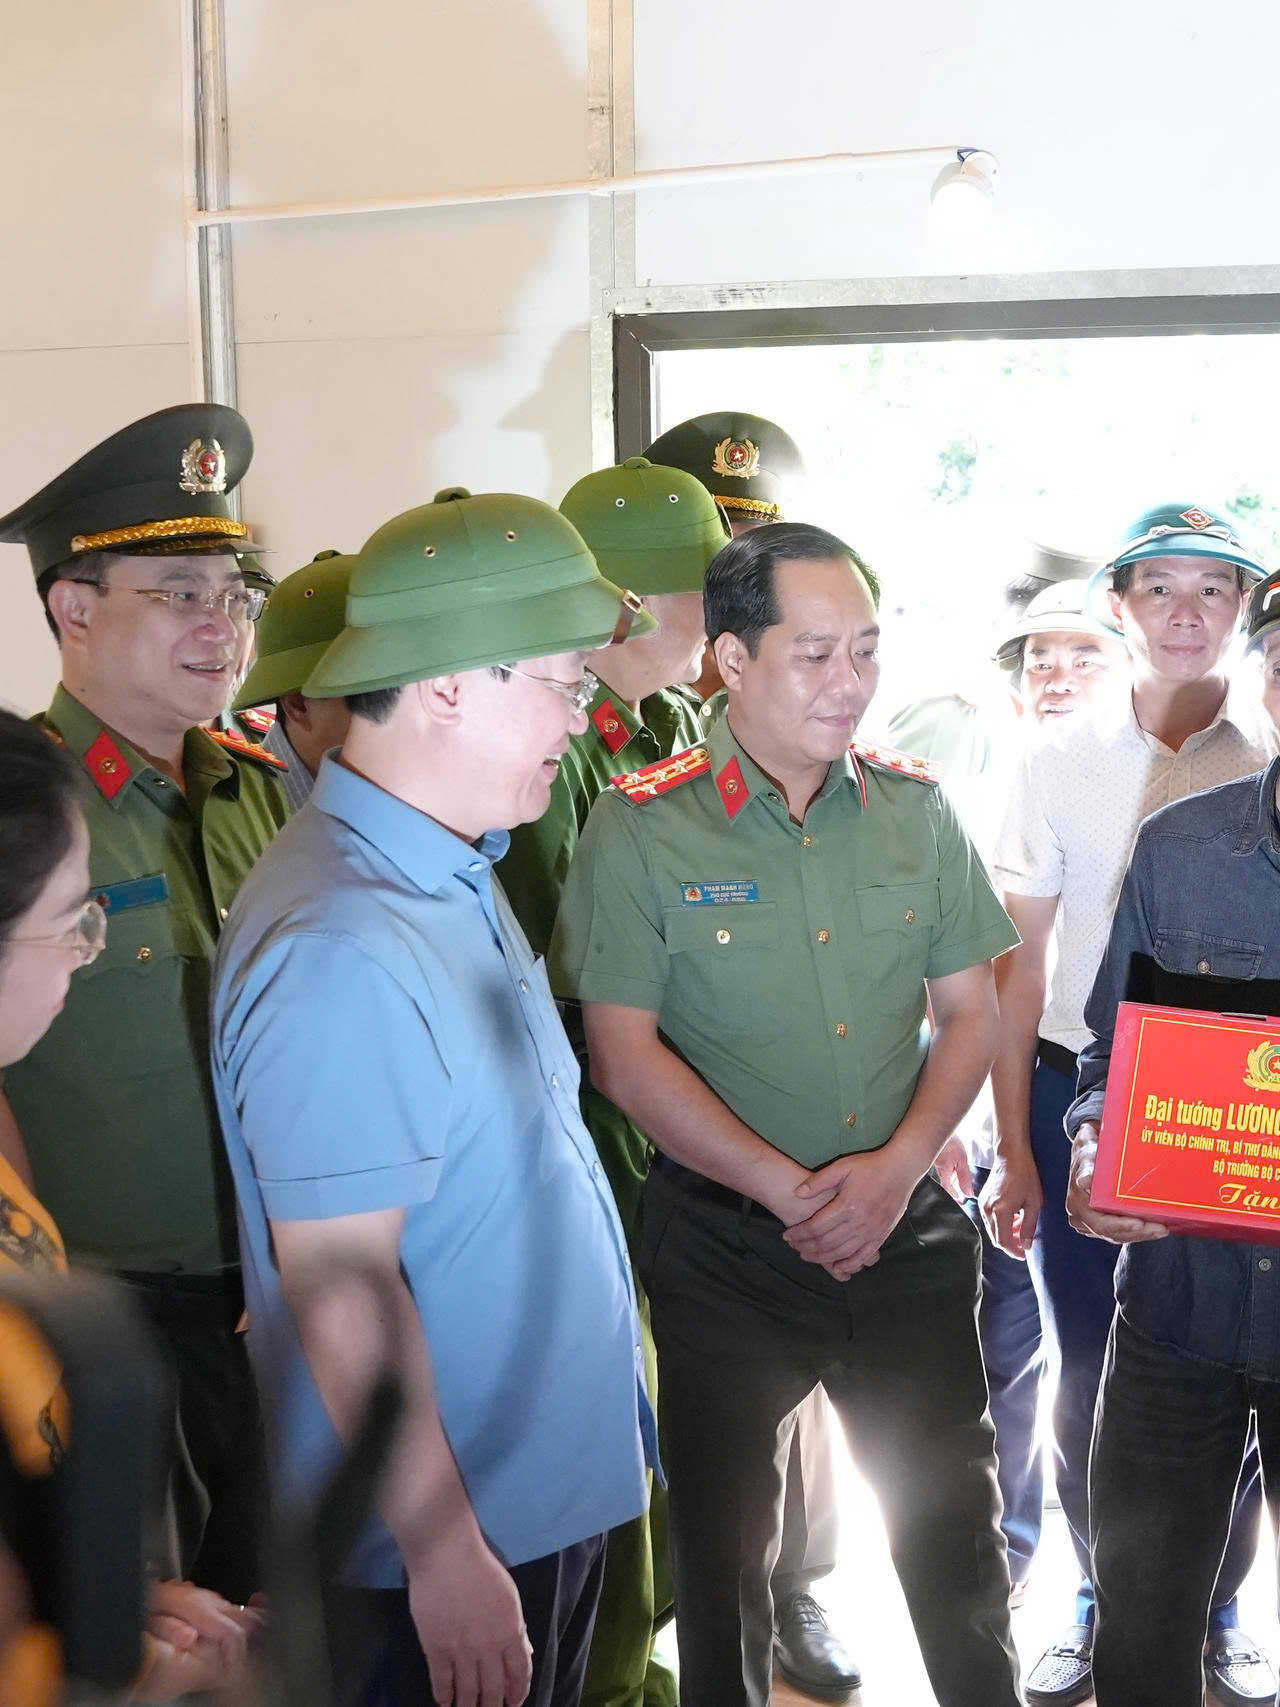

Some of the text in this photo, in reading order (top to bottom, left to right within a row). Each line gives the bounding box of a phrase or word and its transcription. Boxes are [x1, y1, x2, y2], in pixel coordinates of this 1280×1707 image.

[1144, 1094, 1174, 1126] Đại
[1176, 1099, 1223, 1132] tướng
[1154, 1129, 1174, 1146] VIÊN
[1175, 1132, 1187, 1150] BỘ
[1188, 1134, 1214, 1152] CHÍNH
[1233, 1139, 1243, 1155] BÍ
[1243, 1142, 1261, 1157] THƯ
[1213, 1158, 1225, 1176] BỘ
[1261, 1164, 1273, 1182] BỘ
